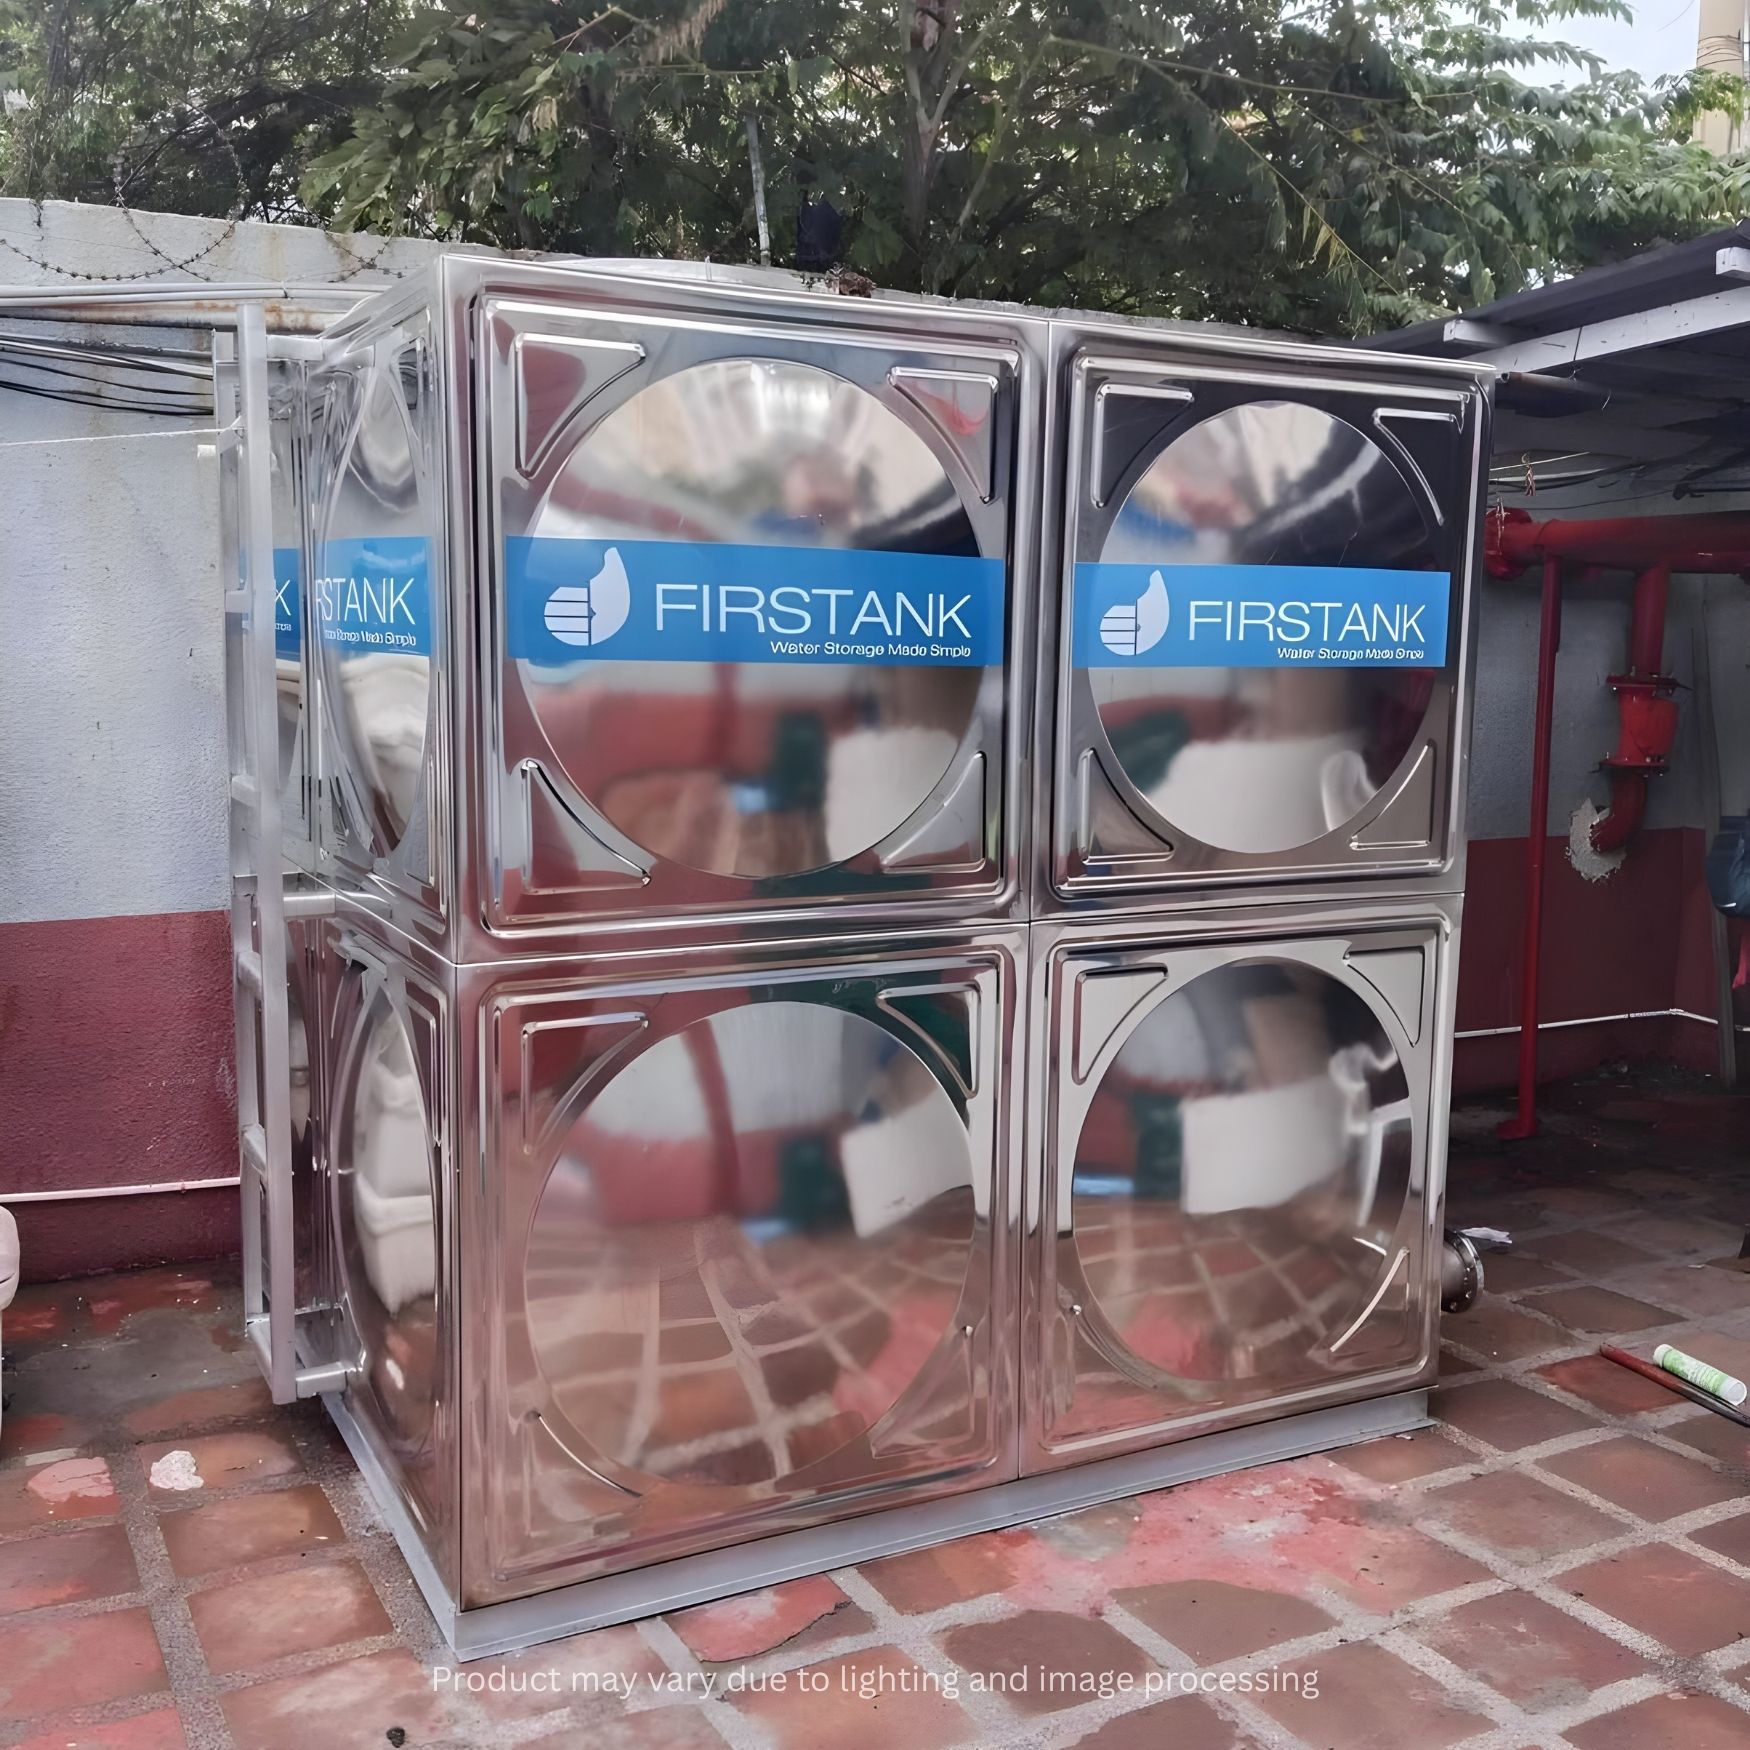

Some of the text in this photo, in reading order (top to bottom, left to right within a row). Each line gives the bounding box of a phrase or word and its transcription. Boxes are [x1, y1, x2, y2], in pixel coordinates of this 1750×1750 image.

[315, 576, 416, 625] RSTANK
[655, 583, 972, 639] FIRSTANK
[1188, 600, 1426, 644] FIRSTANK
[770, 641, 820, 655] Water
[824, 641, 885, 658] Storage
[888, 643, 927, 656] Made
